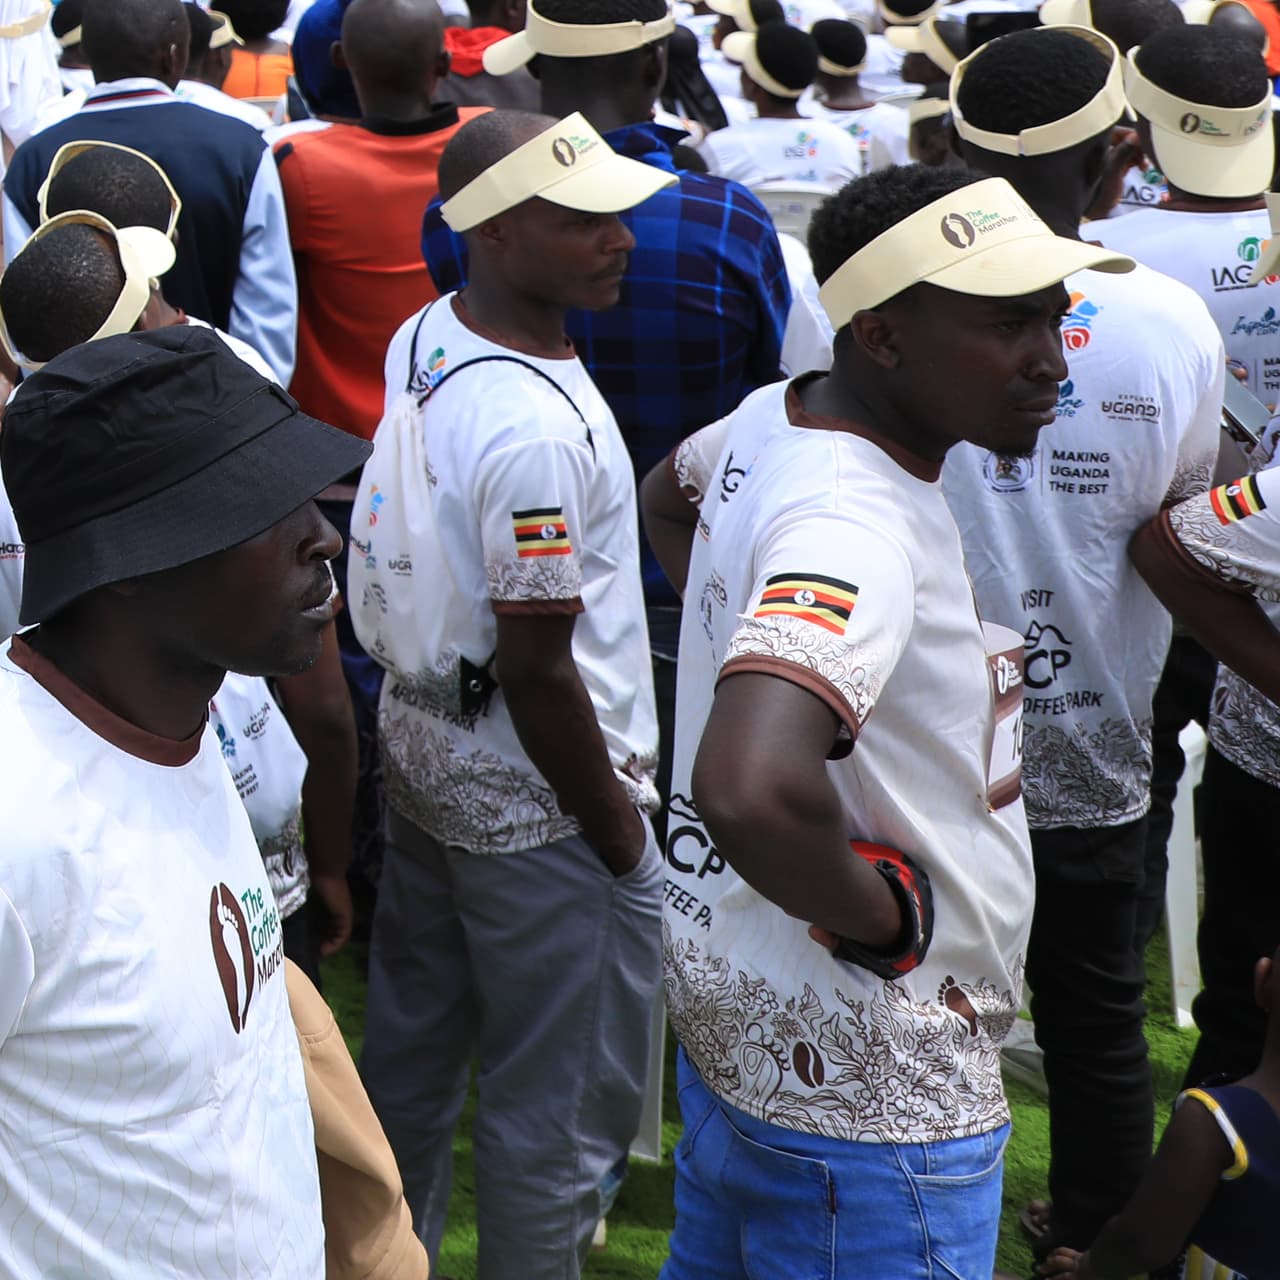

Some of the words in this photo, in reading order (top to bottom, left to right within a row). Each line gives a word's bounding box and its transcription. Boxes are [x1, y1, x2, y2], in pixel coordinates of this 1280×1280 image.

[966, 210, 983, 220] The
[1051, 450, 1111, 463] MAKING
[1050, 465, 1110, 479] UGANDA
[1049, 481, 1077, 494] THE
[1078, 482, 1109, 495] BEST
[1023, 648, 1072, 689] CP
[1023, 695, 1065, 715] OFFEE
[1066, 690, 1104, 712] PARK
[666, 825, 726, 880] CP
[241, 887, 264, 924] The
